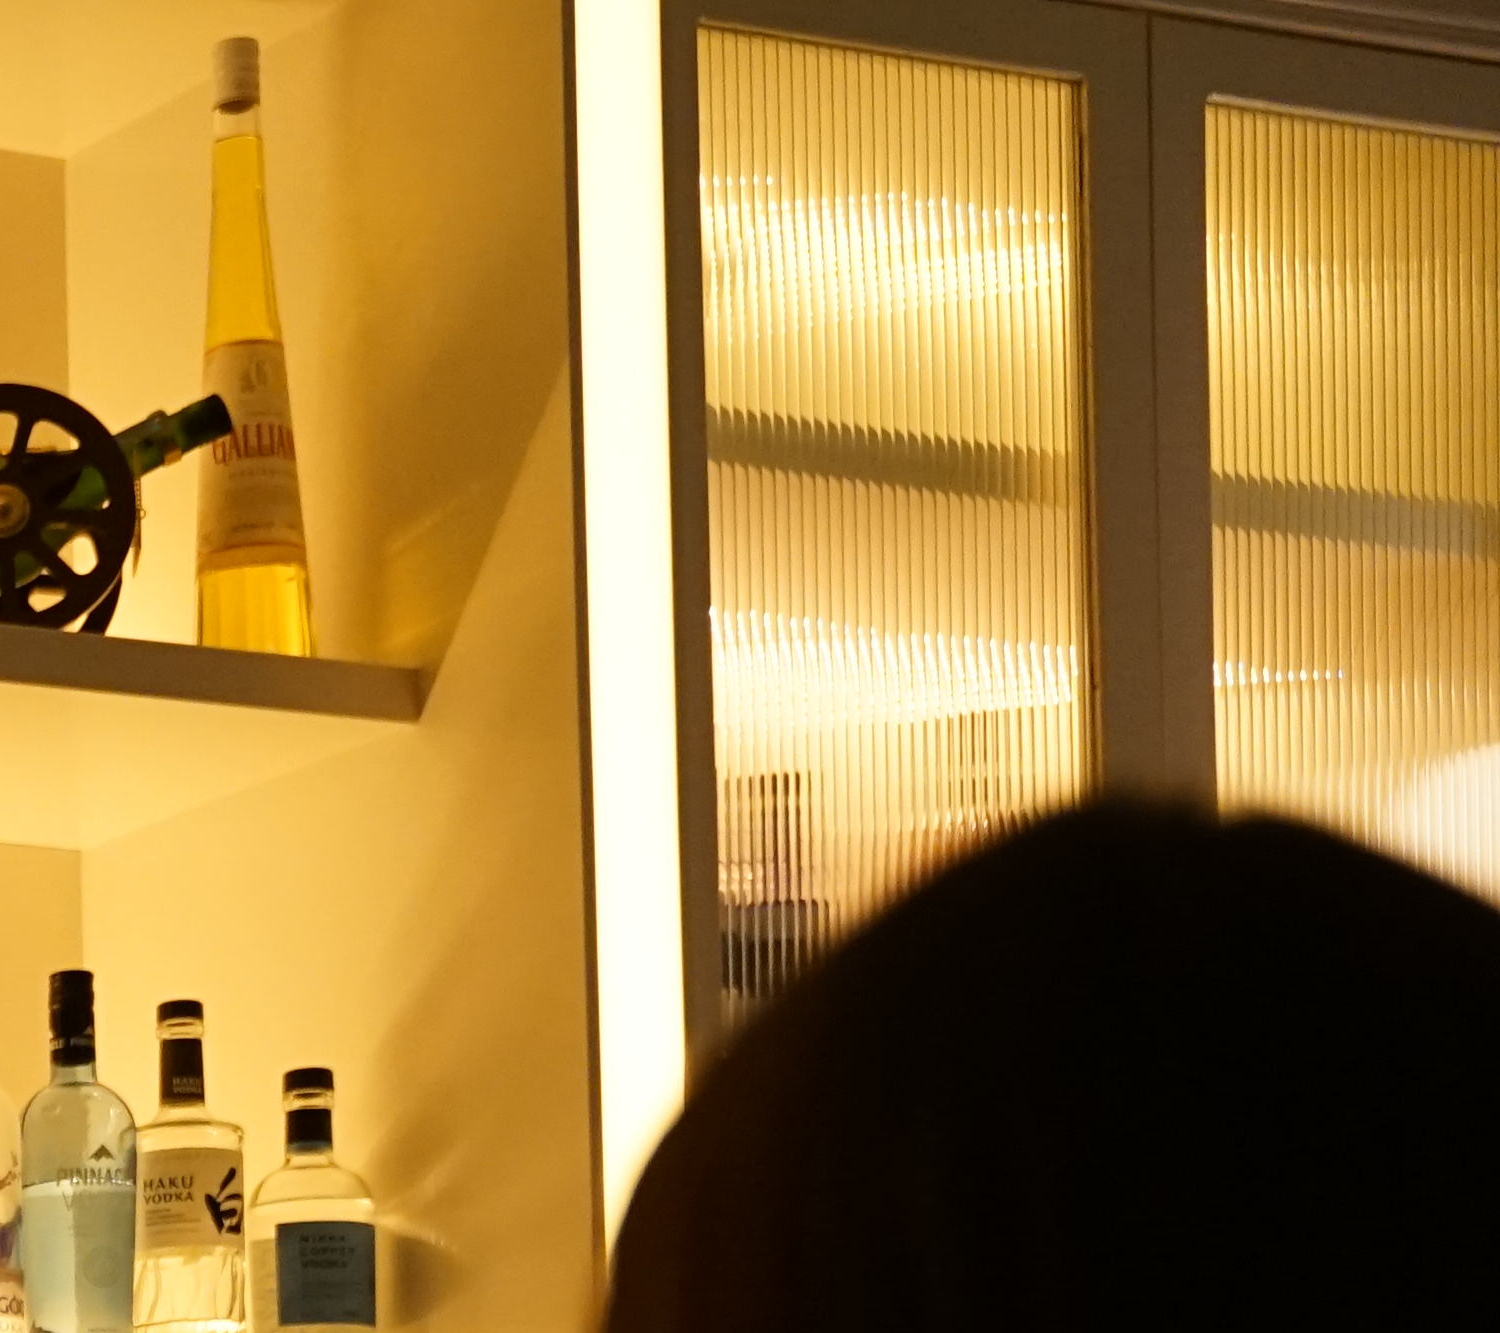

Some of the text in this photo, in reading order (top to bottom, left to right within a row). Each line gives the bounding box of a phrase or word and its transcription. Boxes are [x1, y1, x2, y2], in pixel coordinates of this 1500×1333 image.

[56, 1166, 132, 1189] PINNAC
[143, 1174, 195, 1191] HAKU
[143, 1192, 194, 1207] VODKA
